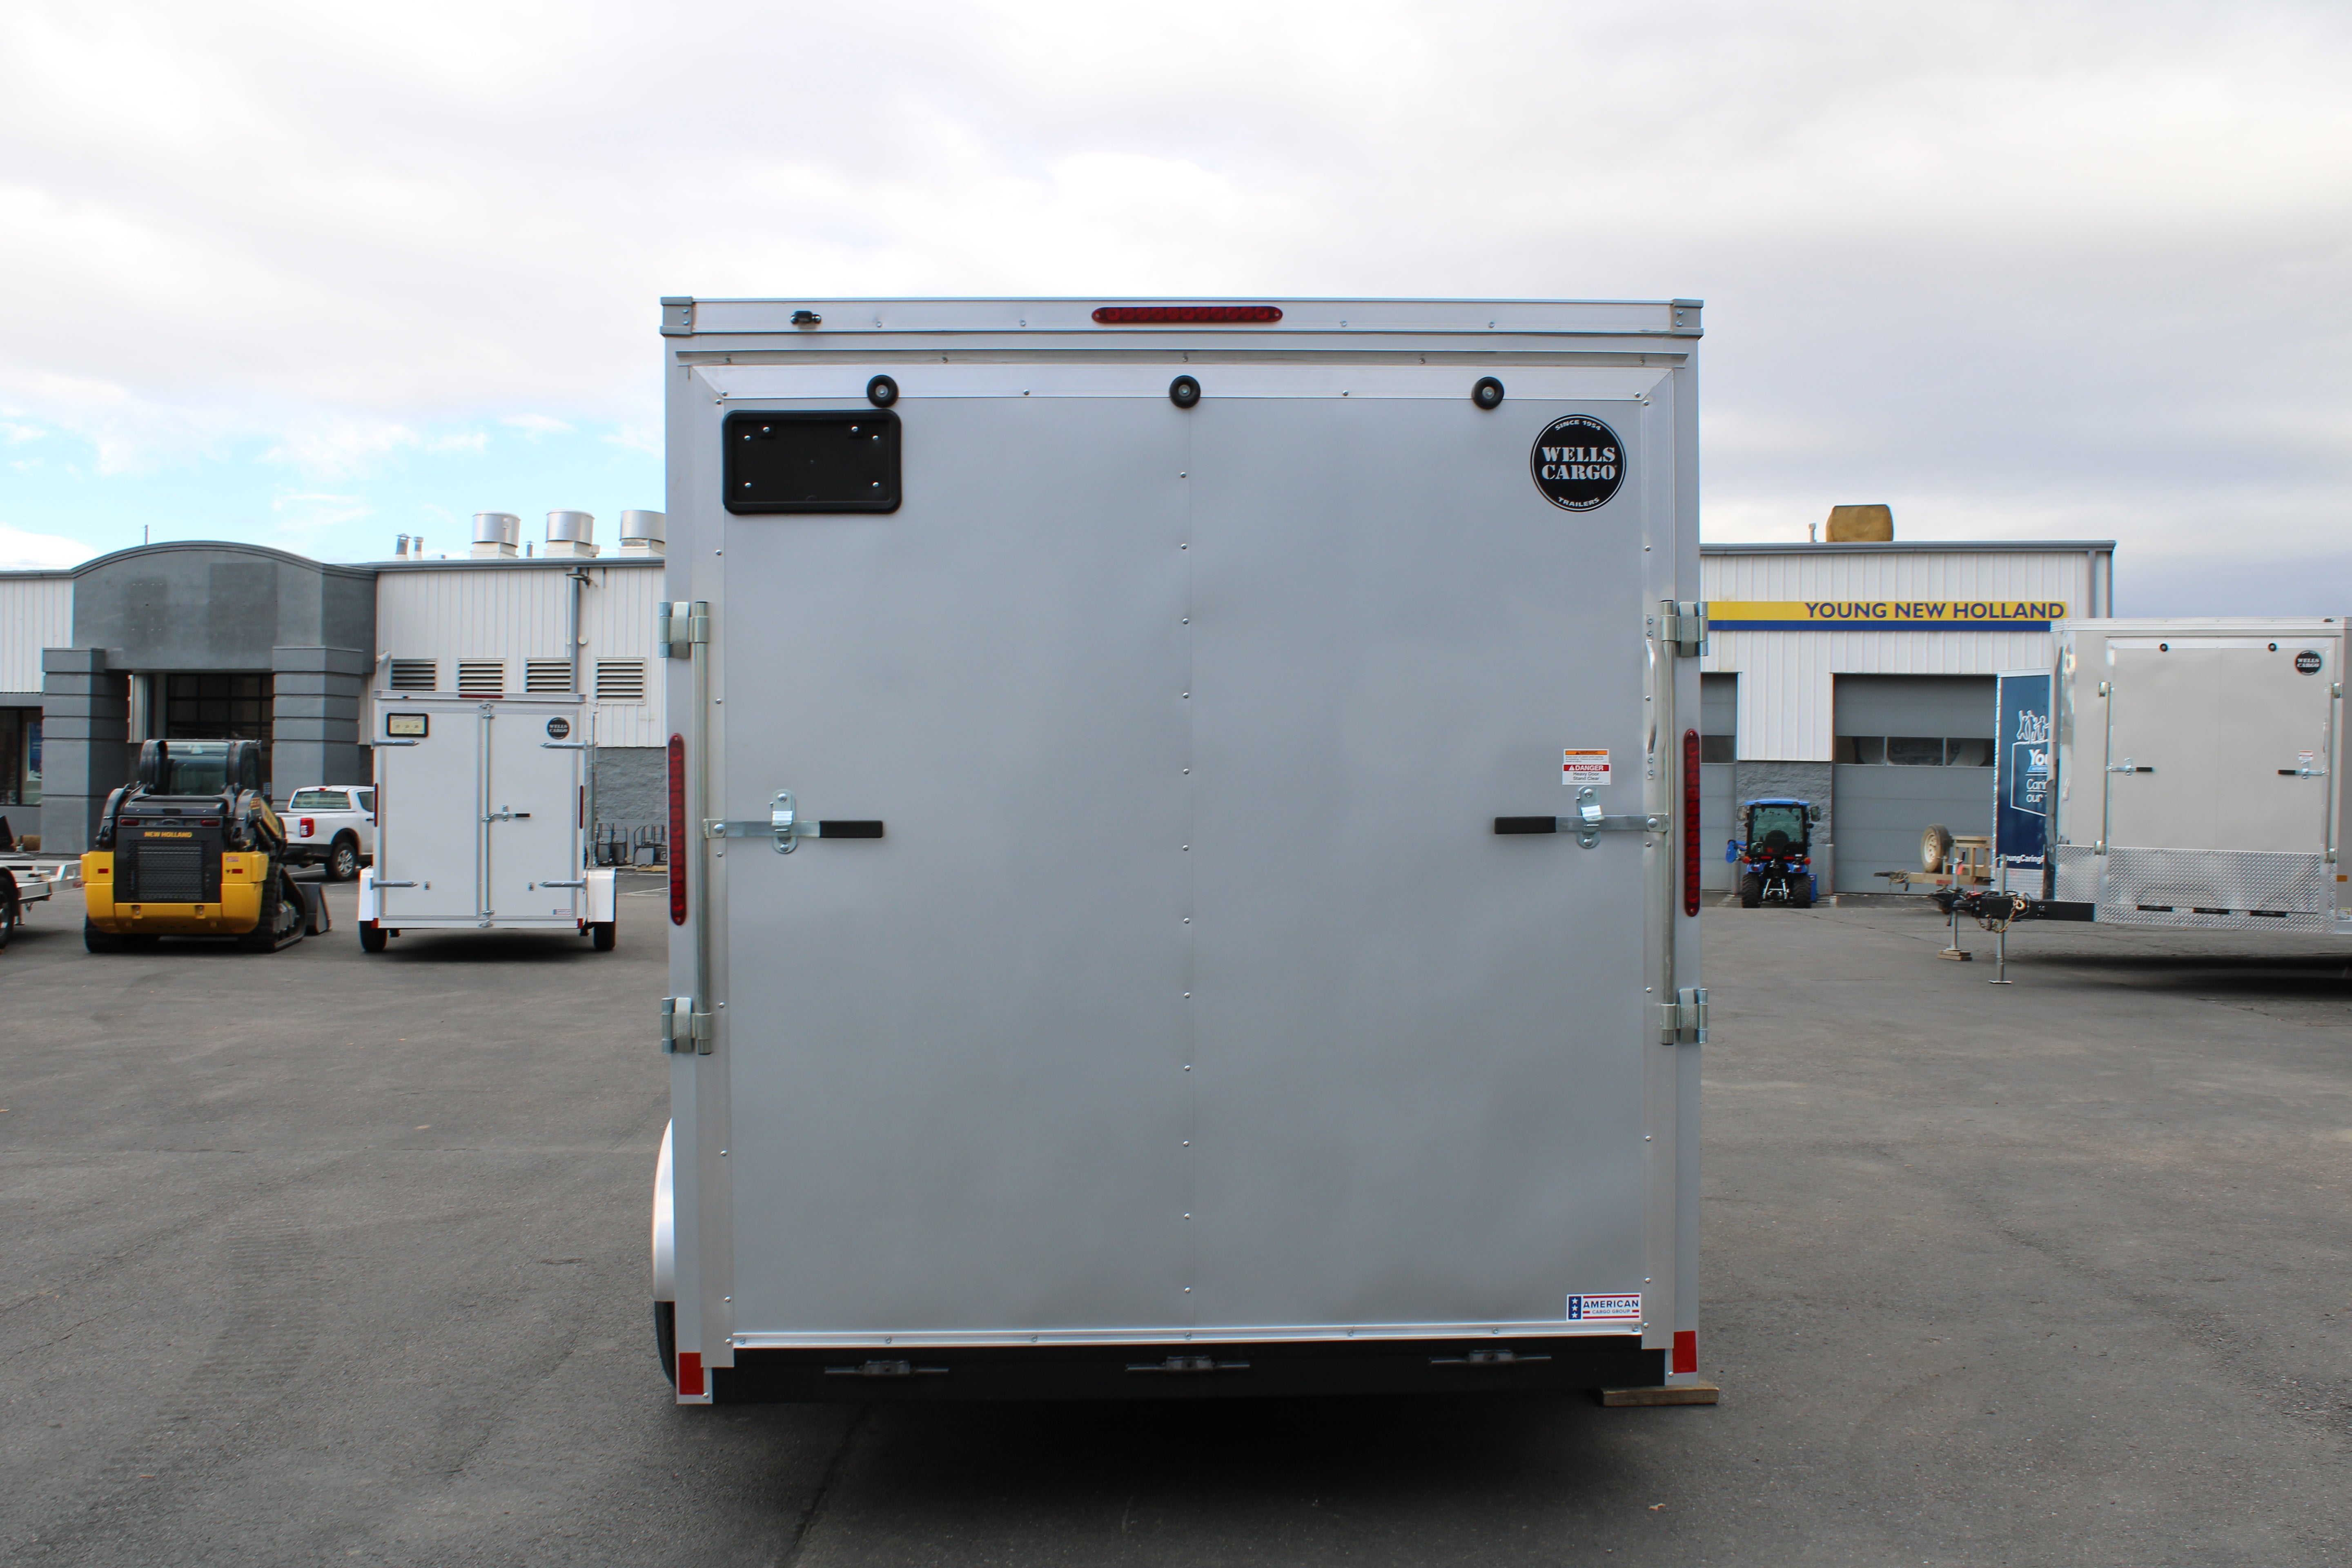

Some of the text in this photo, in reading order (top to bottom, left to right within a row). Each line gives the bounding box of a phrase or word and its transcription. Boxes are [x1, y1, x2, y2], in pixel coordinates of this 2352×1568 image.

[1555, 420, 1601, 431] SINCE 1954
[1542, 447, 1615, 462] WELLS
[1541, 465, 1616, 480] CARGO
[1558, 497, 1600, 507] TRAILERS
[1805, 603, 2064, 618] YOUNG NEW HOLLAND
[2026, 794, 2043, 802] our
[1583, 1300, 1639, 1308] AMERICAN
